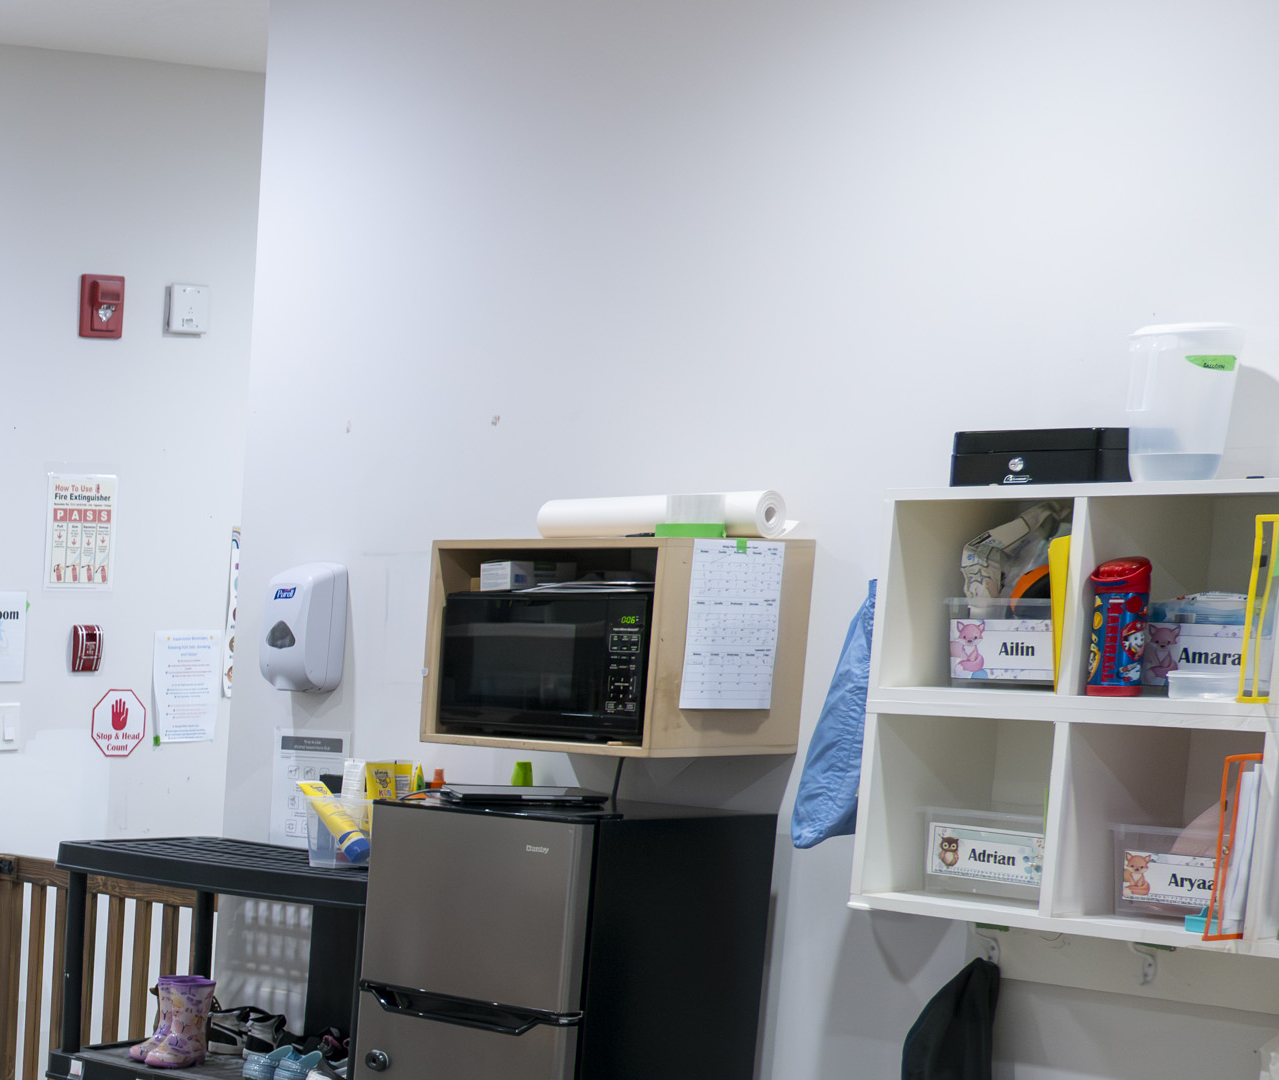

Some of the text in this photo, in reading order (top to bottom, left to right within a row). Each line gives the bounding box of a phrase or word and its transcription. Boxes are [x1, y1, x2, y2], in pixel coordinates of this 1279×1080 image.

[55, 484, 93, 492] How To Use
[69, 493, 111, 502] Extinguisher
[998, 642, 1035, 656] Ailin
[1178, 647, 1241, 666] Amara
[96, 732, 140, 741] Stop & Head
[968, 848, 1016, 867] Adrian
[1168, 873, 1215, 892] Aryaa
